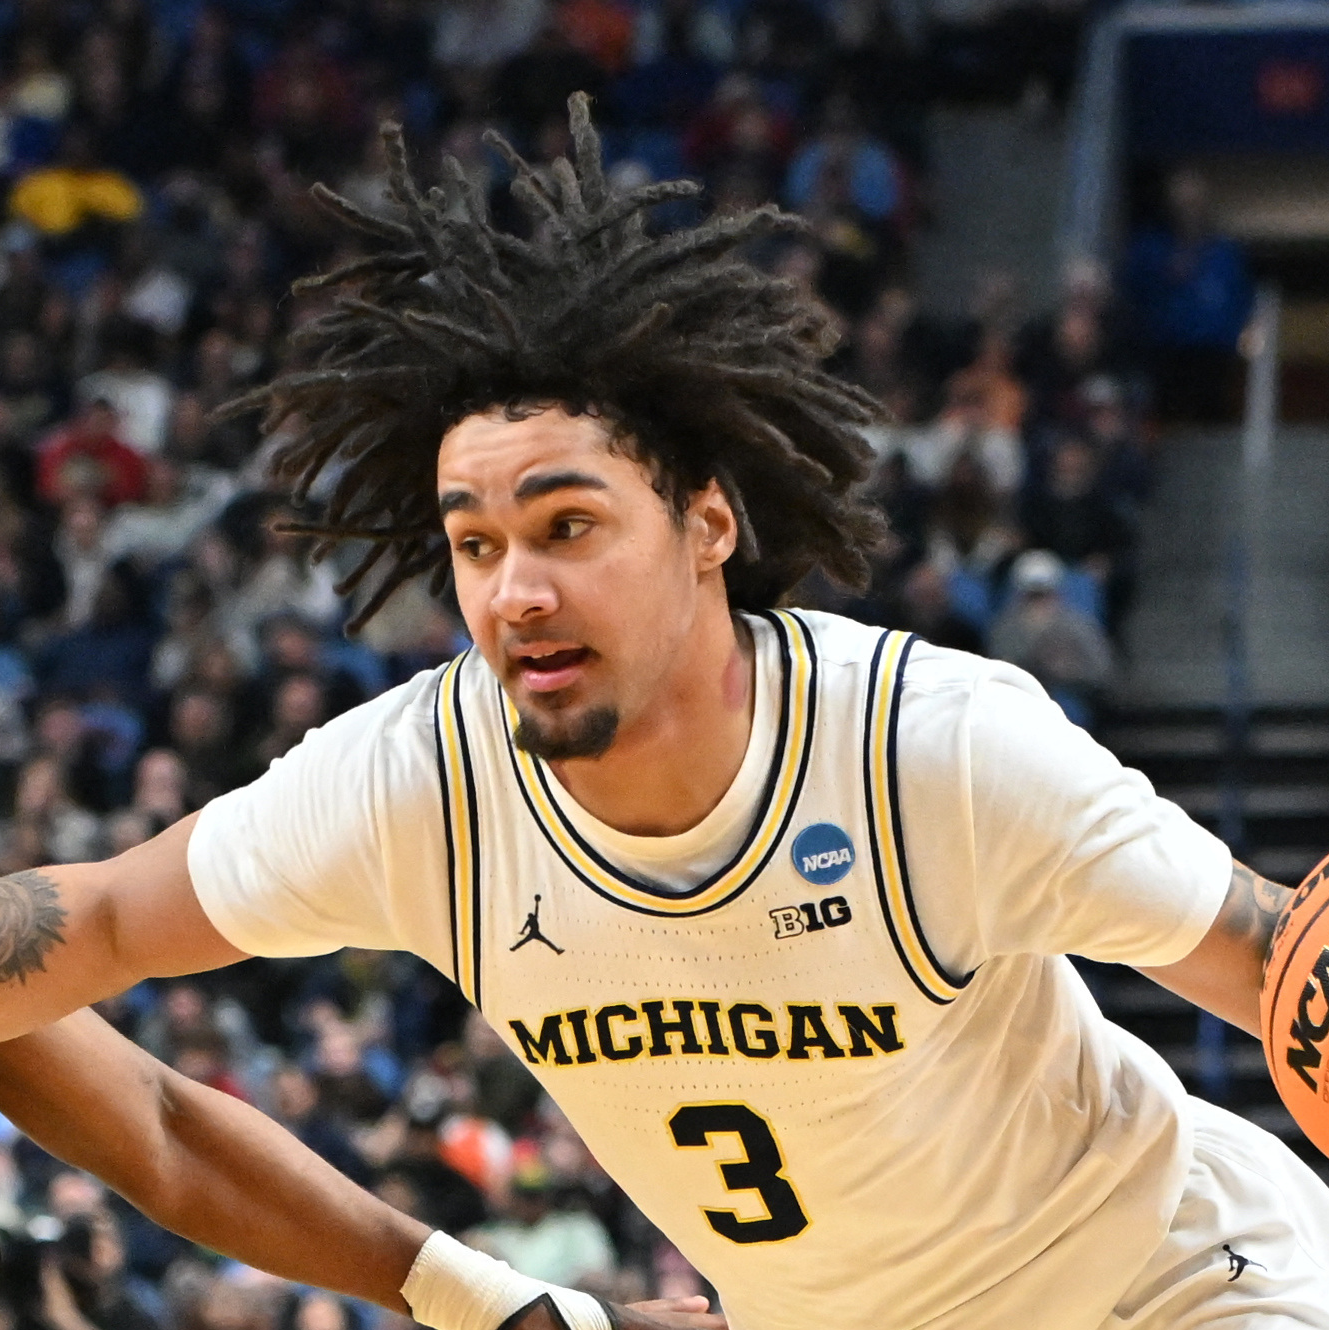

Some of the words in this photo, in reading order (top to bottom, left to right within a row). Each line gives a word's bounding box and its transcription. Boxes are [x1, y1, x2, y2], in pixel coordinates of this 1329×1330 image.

[802, 848, 851, 873] NCAA
[507, 997, 908, 1068] MICHIGAN
[664, 1099, 814, 1247] 3
